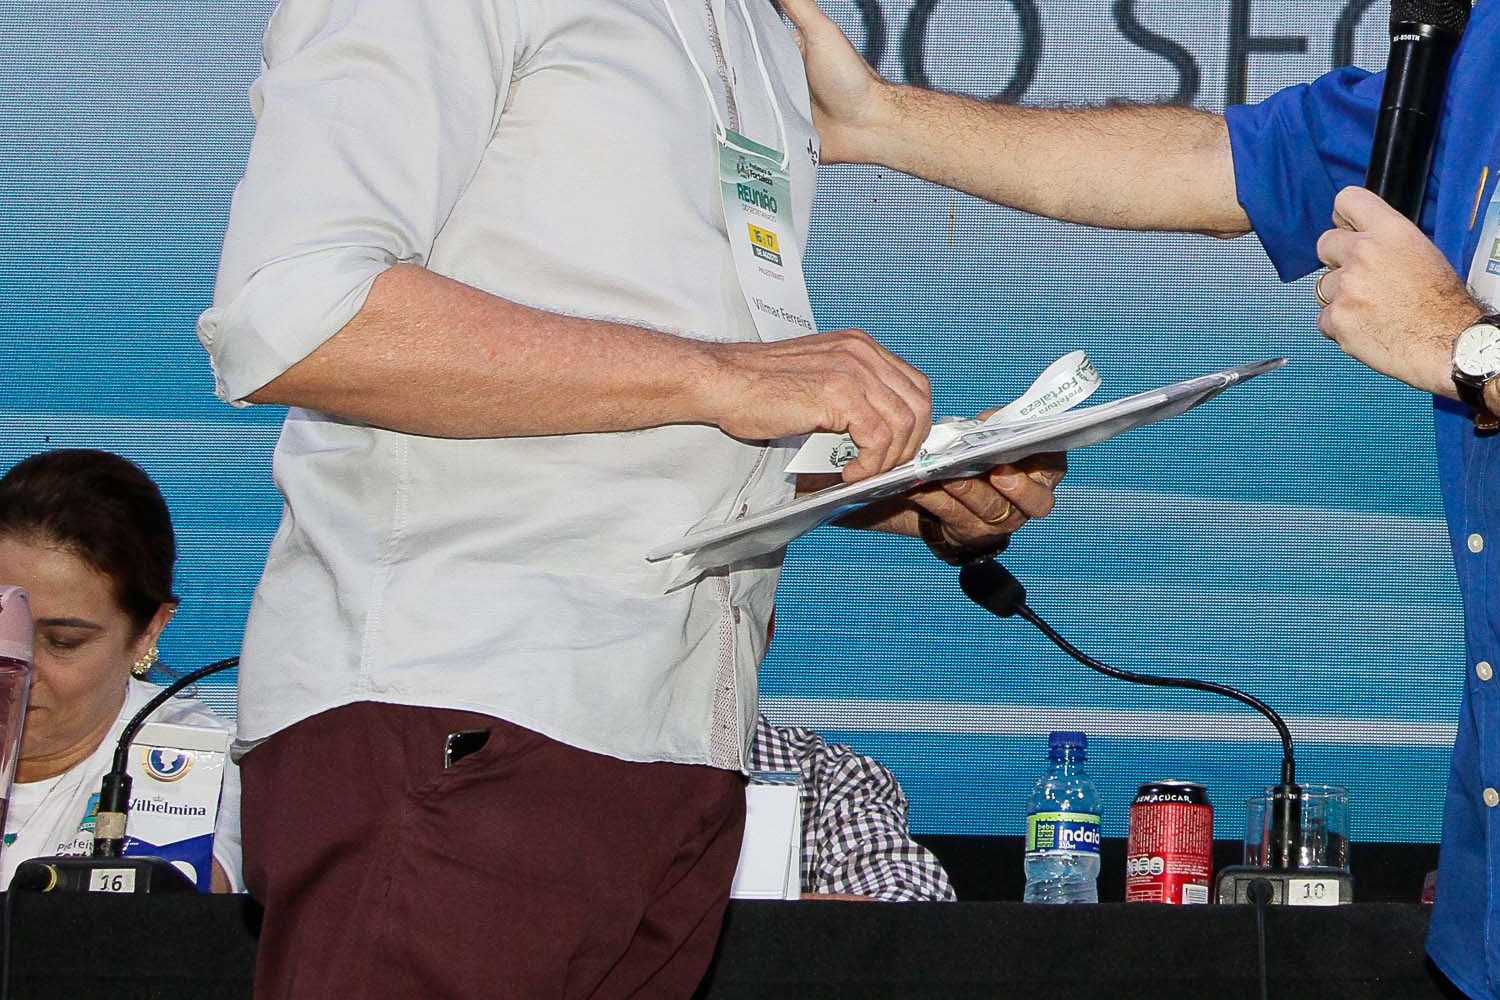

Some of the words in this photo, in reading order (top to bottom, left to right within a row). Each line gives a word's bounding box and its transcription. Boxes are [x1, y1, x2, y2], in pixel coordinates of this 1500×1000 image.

[736, 182, 777, 213] REUNIÃO
[752, 295, 780, 318] Vilmar
[780, 307, 813, 330] Ferreira
[1020, 376, 1079, 416] Fortaleza
[100, 874, 123, 891] 16
[1303, 882, 1325, 899] 10
